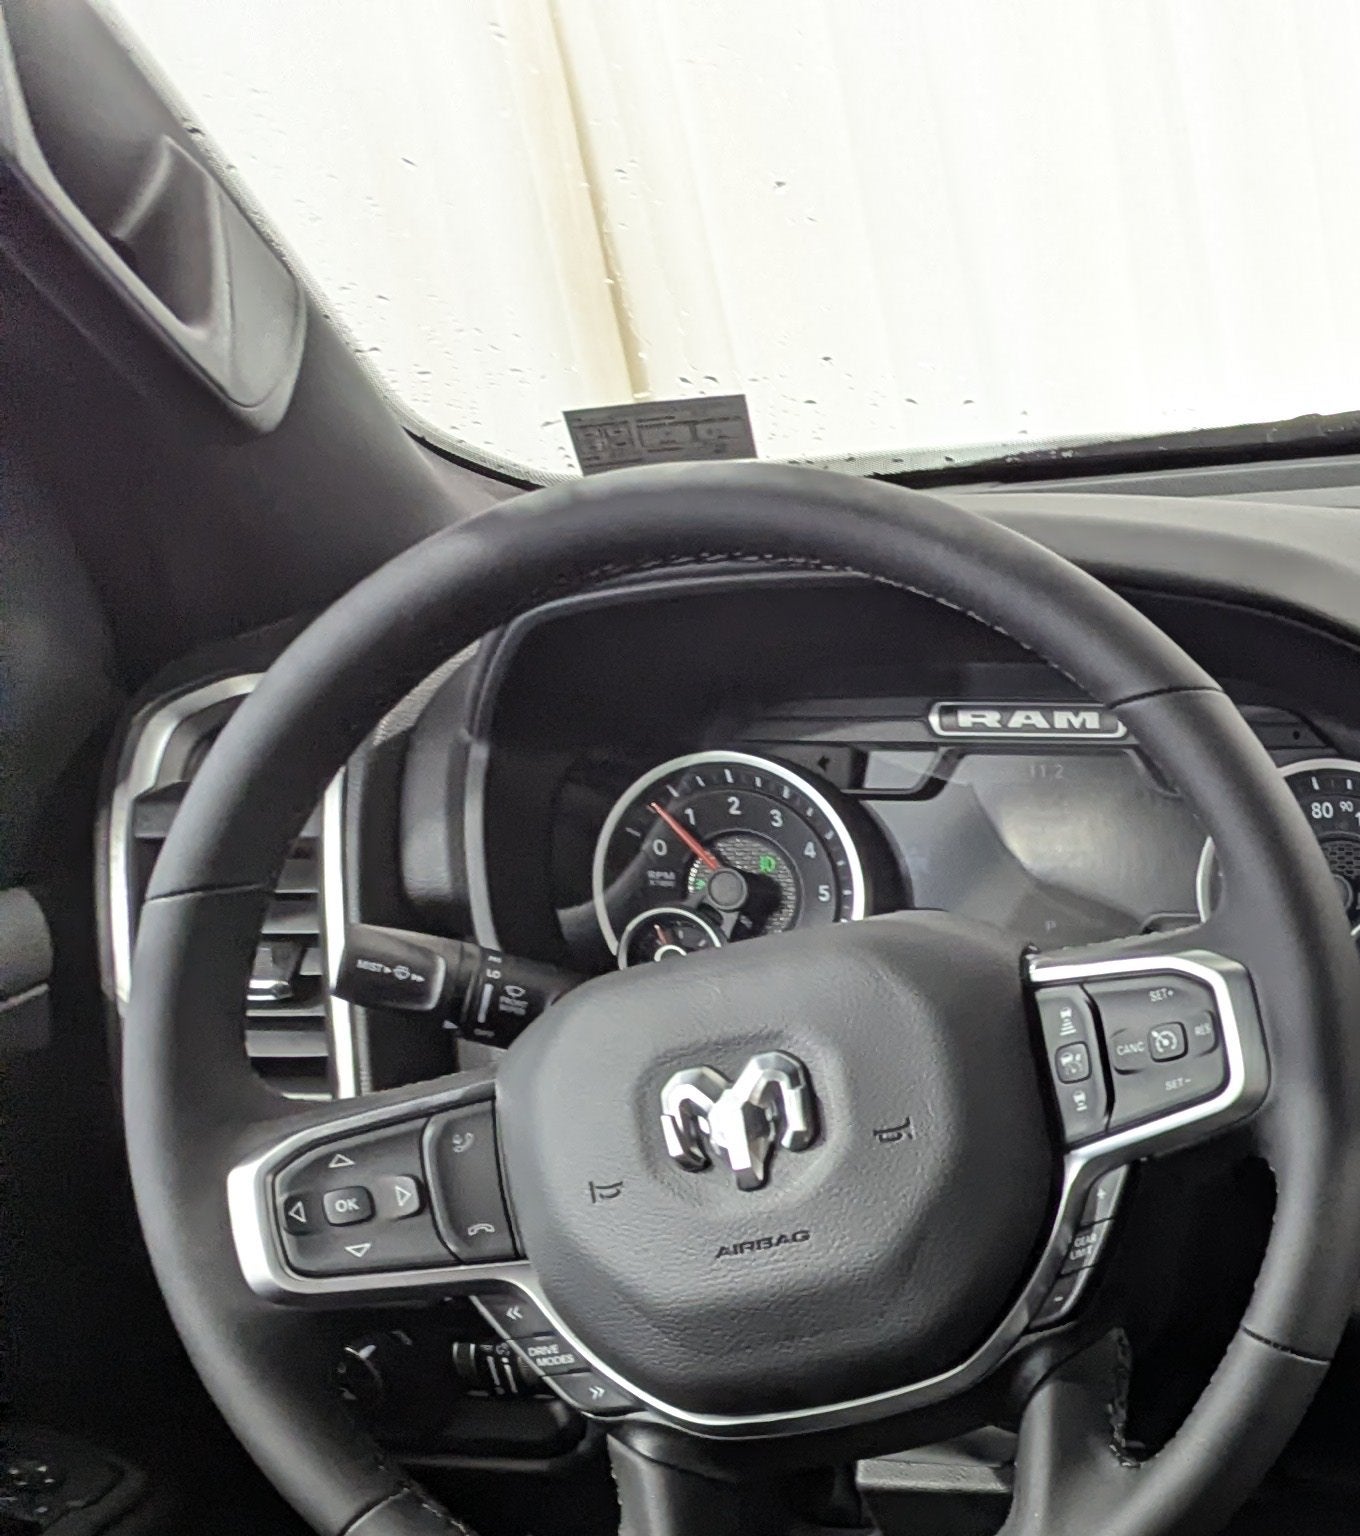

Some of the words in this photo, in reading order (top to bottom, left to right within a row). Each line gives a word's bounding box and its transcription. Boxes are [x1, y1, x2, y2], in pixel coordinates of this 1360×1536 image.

[956, 710, 1101, 729] RAM
[728, 796, 742, 816] 2
[1311, 802, 1334, 819] 80
[1339, 801, 1354, 813] 90
[684, 808, 696, 825] 1
[770, 809, 783, 827] 3
[653, 839, 668, 856] 0
[804, 842, 817, 858] 4
[818, 885, 830, 902] 5
[1116, 1041, 1146, 1055] CANC
[335, 1197, 361, 1213] OK
[715, 1230, 812, 1258] AIRBAG
[528, 1343, 559, 1357] DRIVE
[535, 1354, 575, 1367] MODES
